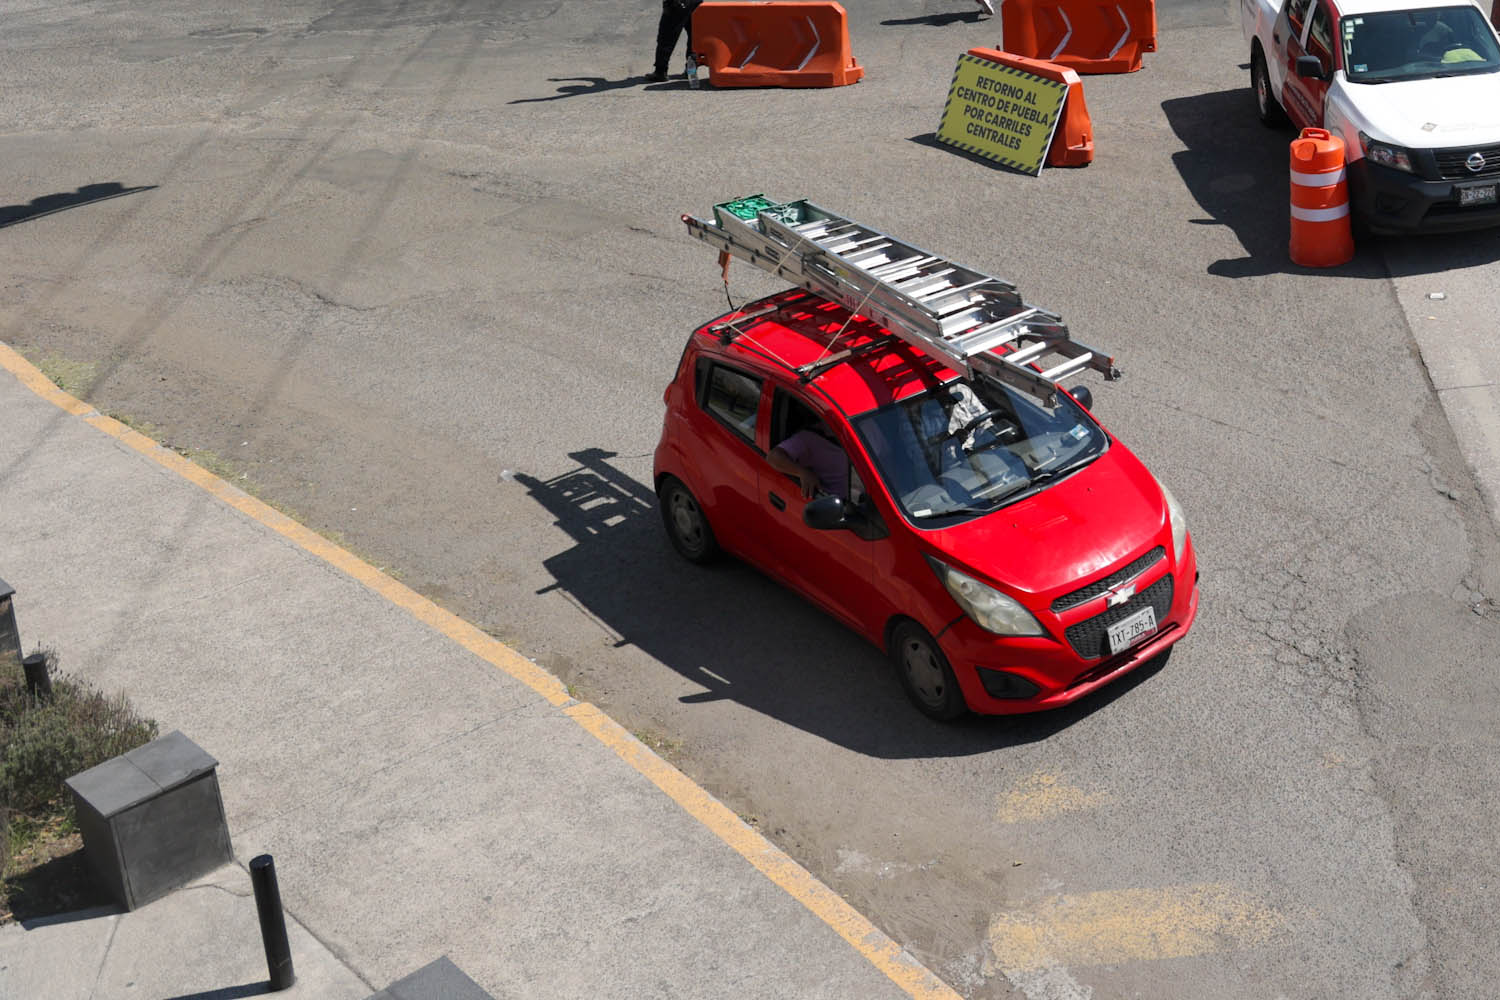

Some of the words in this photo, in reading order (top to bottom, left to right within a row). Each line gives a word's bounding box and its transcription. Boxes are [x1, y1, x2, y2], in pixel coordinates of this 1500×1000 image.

[957, 86, 996, 108] CENTRO
[997, 98, 1011, 113] DE
[1010, 103, 1049, 126] PUEBLA
[976, 76, 1024, 100] RETORNO
[1024, 91, 1037, 105] AL
[964, 104, 985, 121] POR
[985, 112, 1033, 137] CARRILES
[966, 122, 1022, 151] CENTRALES
[1111, 615, 1154, 646] TXT-785-A
